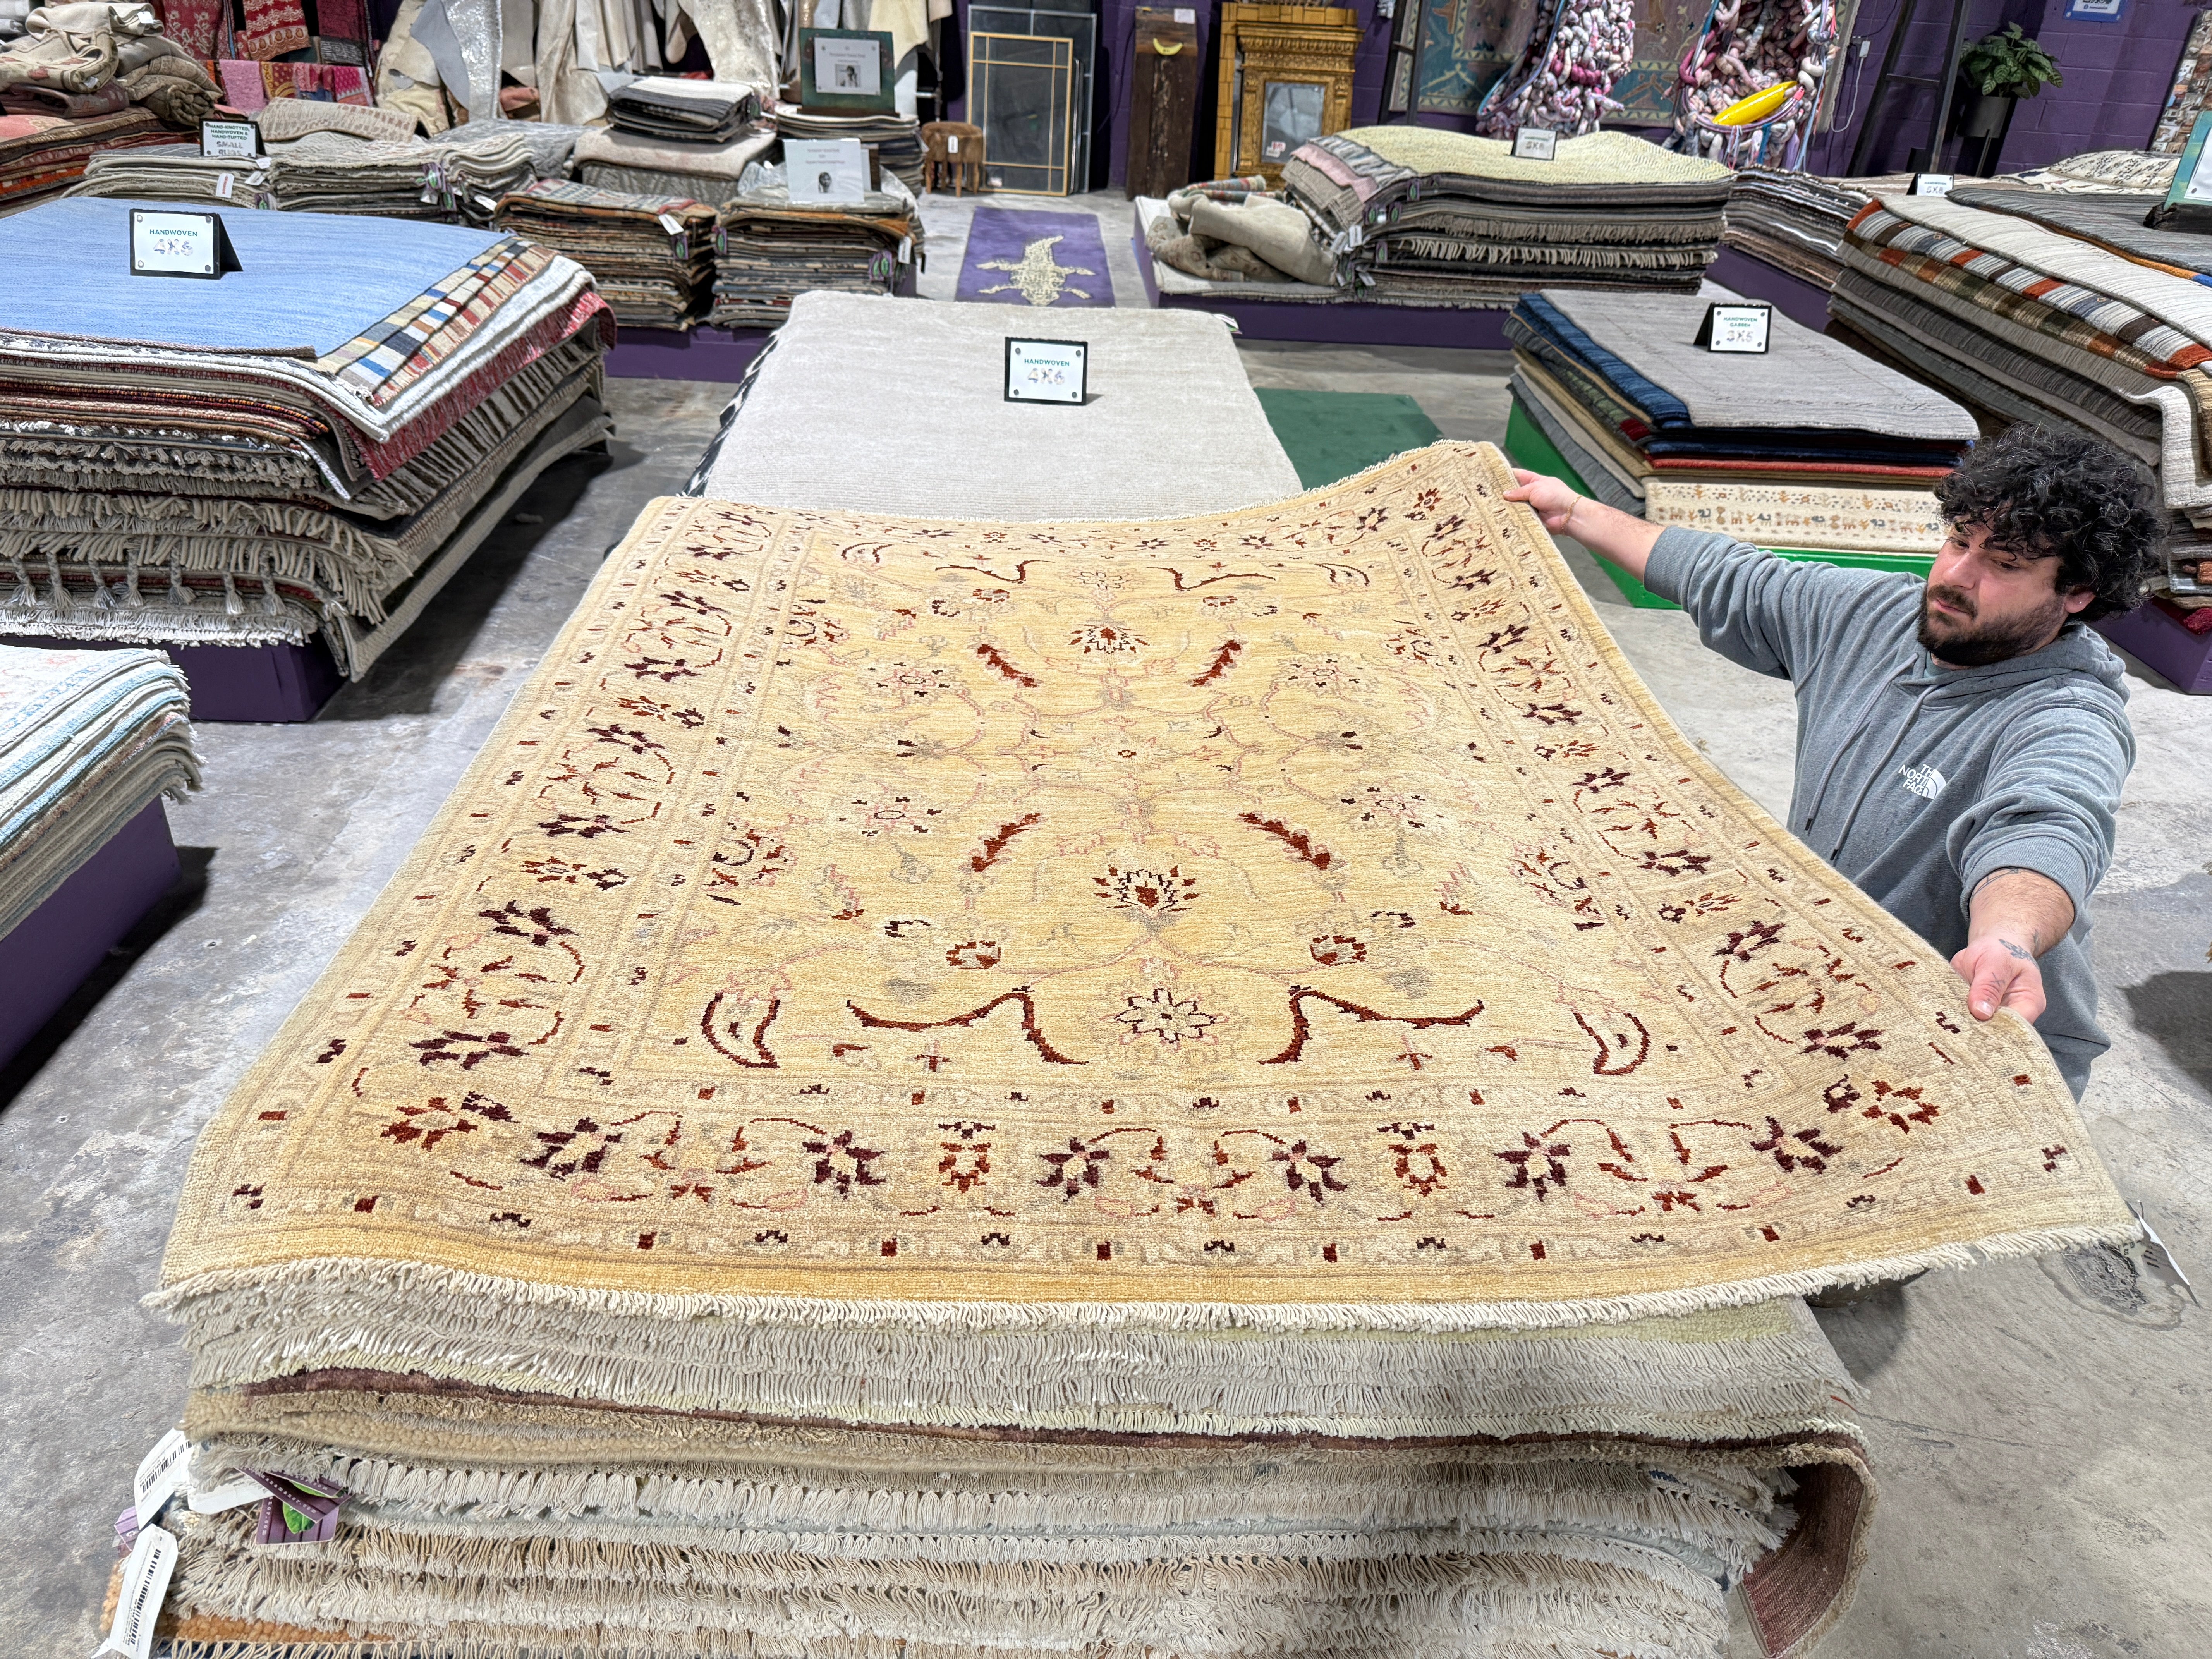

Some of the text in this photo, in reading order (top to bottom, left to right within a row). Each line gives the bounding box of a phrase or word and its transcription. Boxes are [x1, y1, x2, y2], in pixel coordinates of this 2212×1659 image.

[1024, 358, 1070, 366] HANDWOVEN
[1027, 368, 1065, 385] 4X6
[1920, 764, 1935, 778] TH
[1903, 778, 1924, 795] FACE
